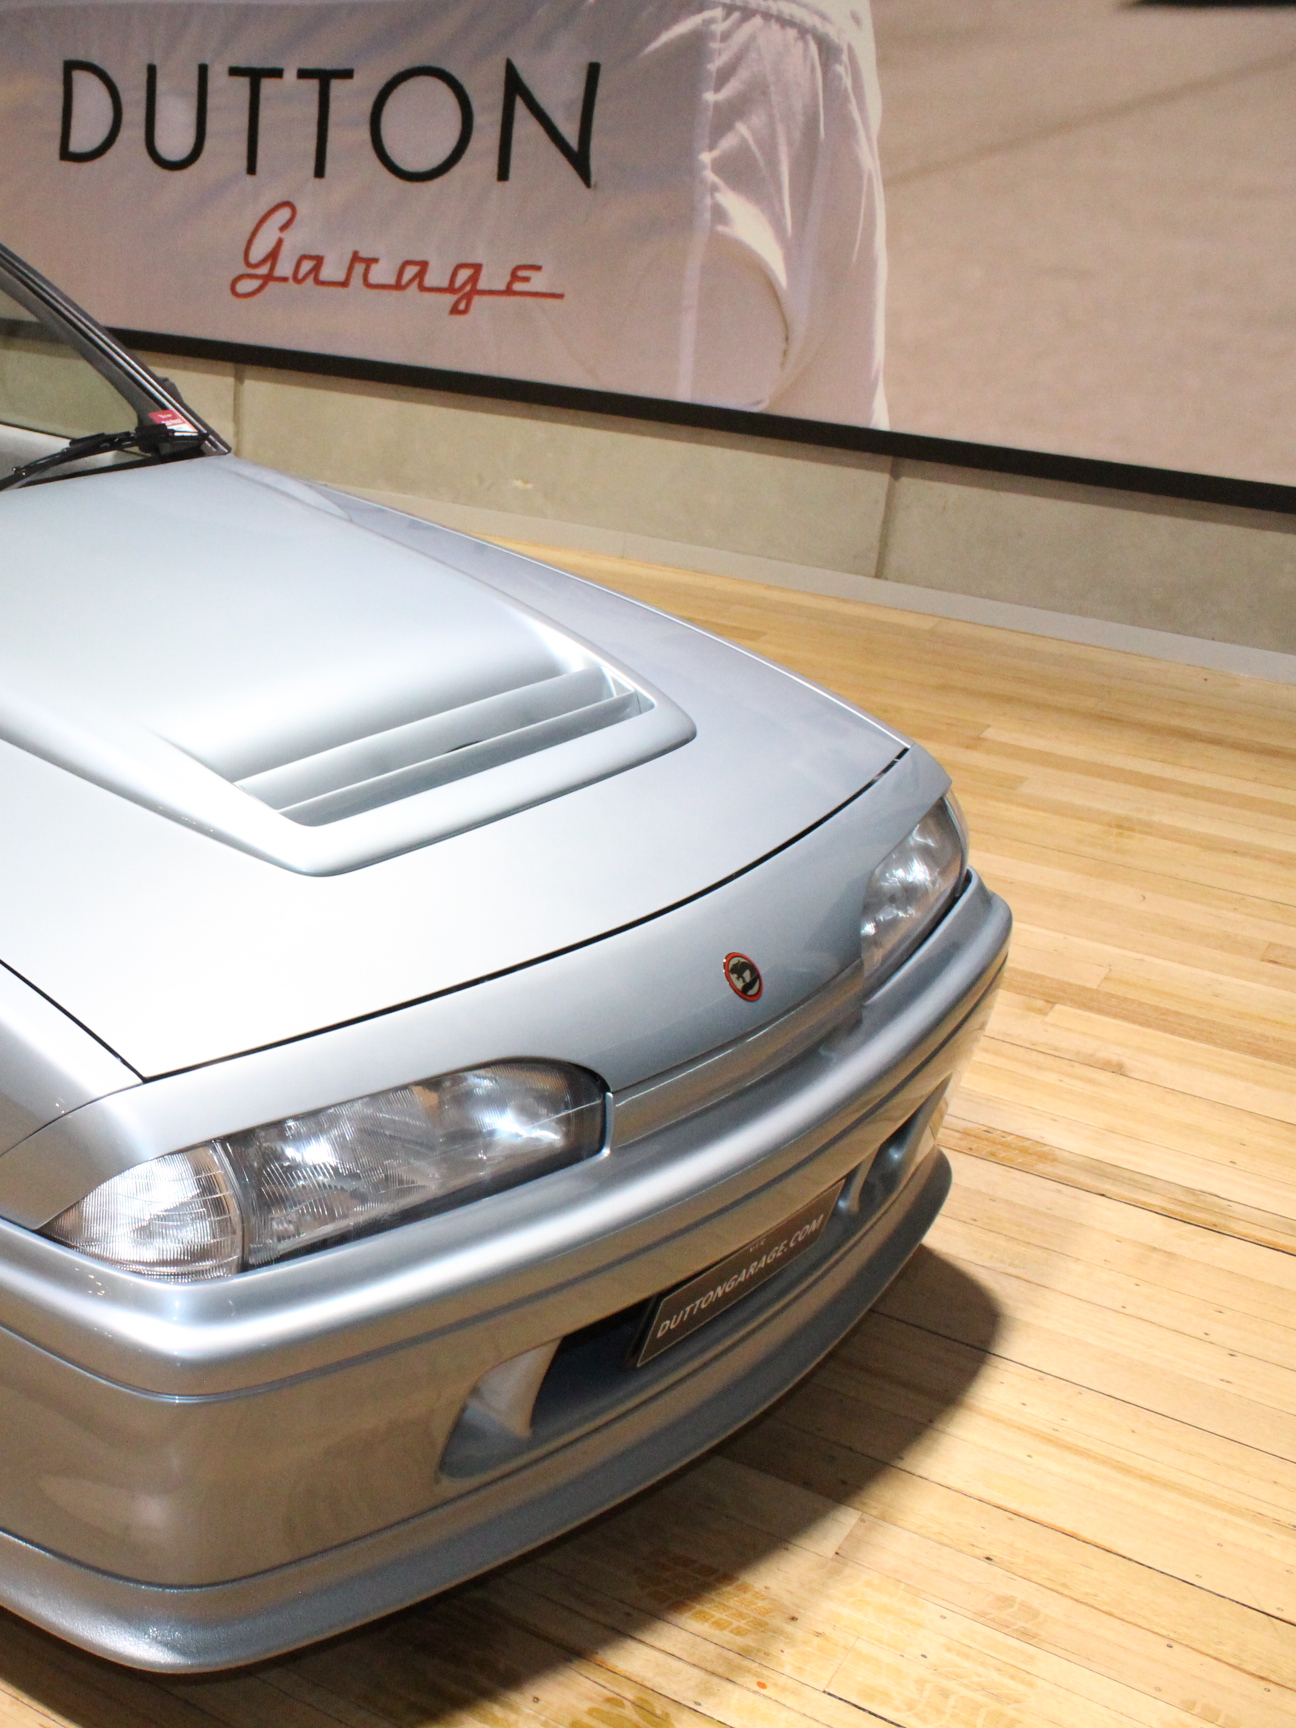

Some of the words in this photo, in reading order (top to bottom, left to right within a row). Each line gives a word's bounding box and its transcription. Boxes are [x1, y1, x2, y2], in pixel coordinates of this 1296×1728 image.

[58, 57, 601, 189] DUTTON
[229, 200, 565, 315] Garage
[656, 1213, 825, 1339] DUTTONGARAGE.COM
